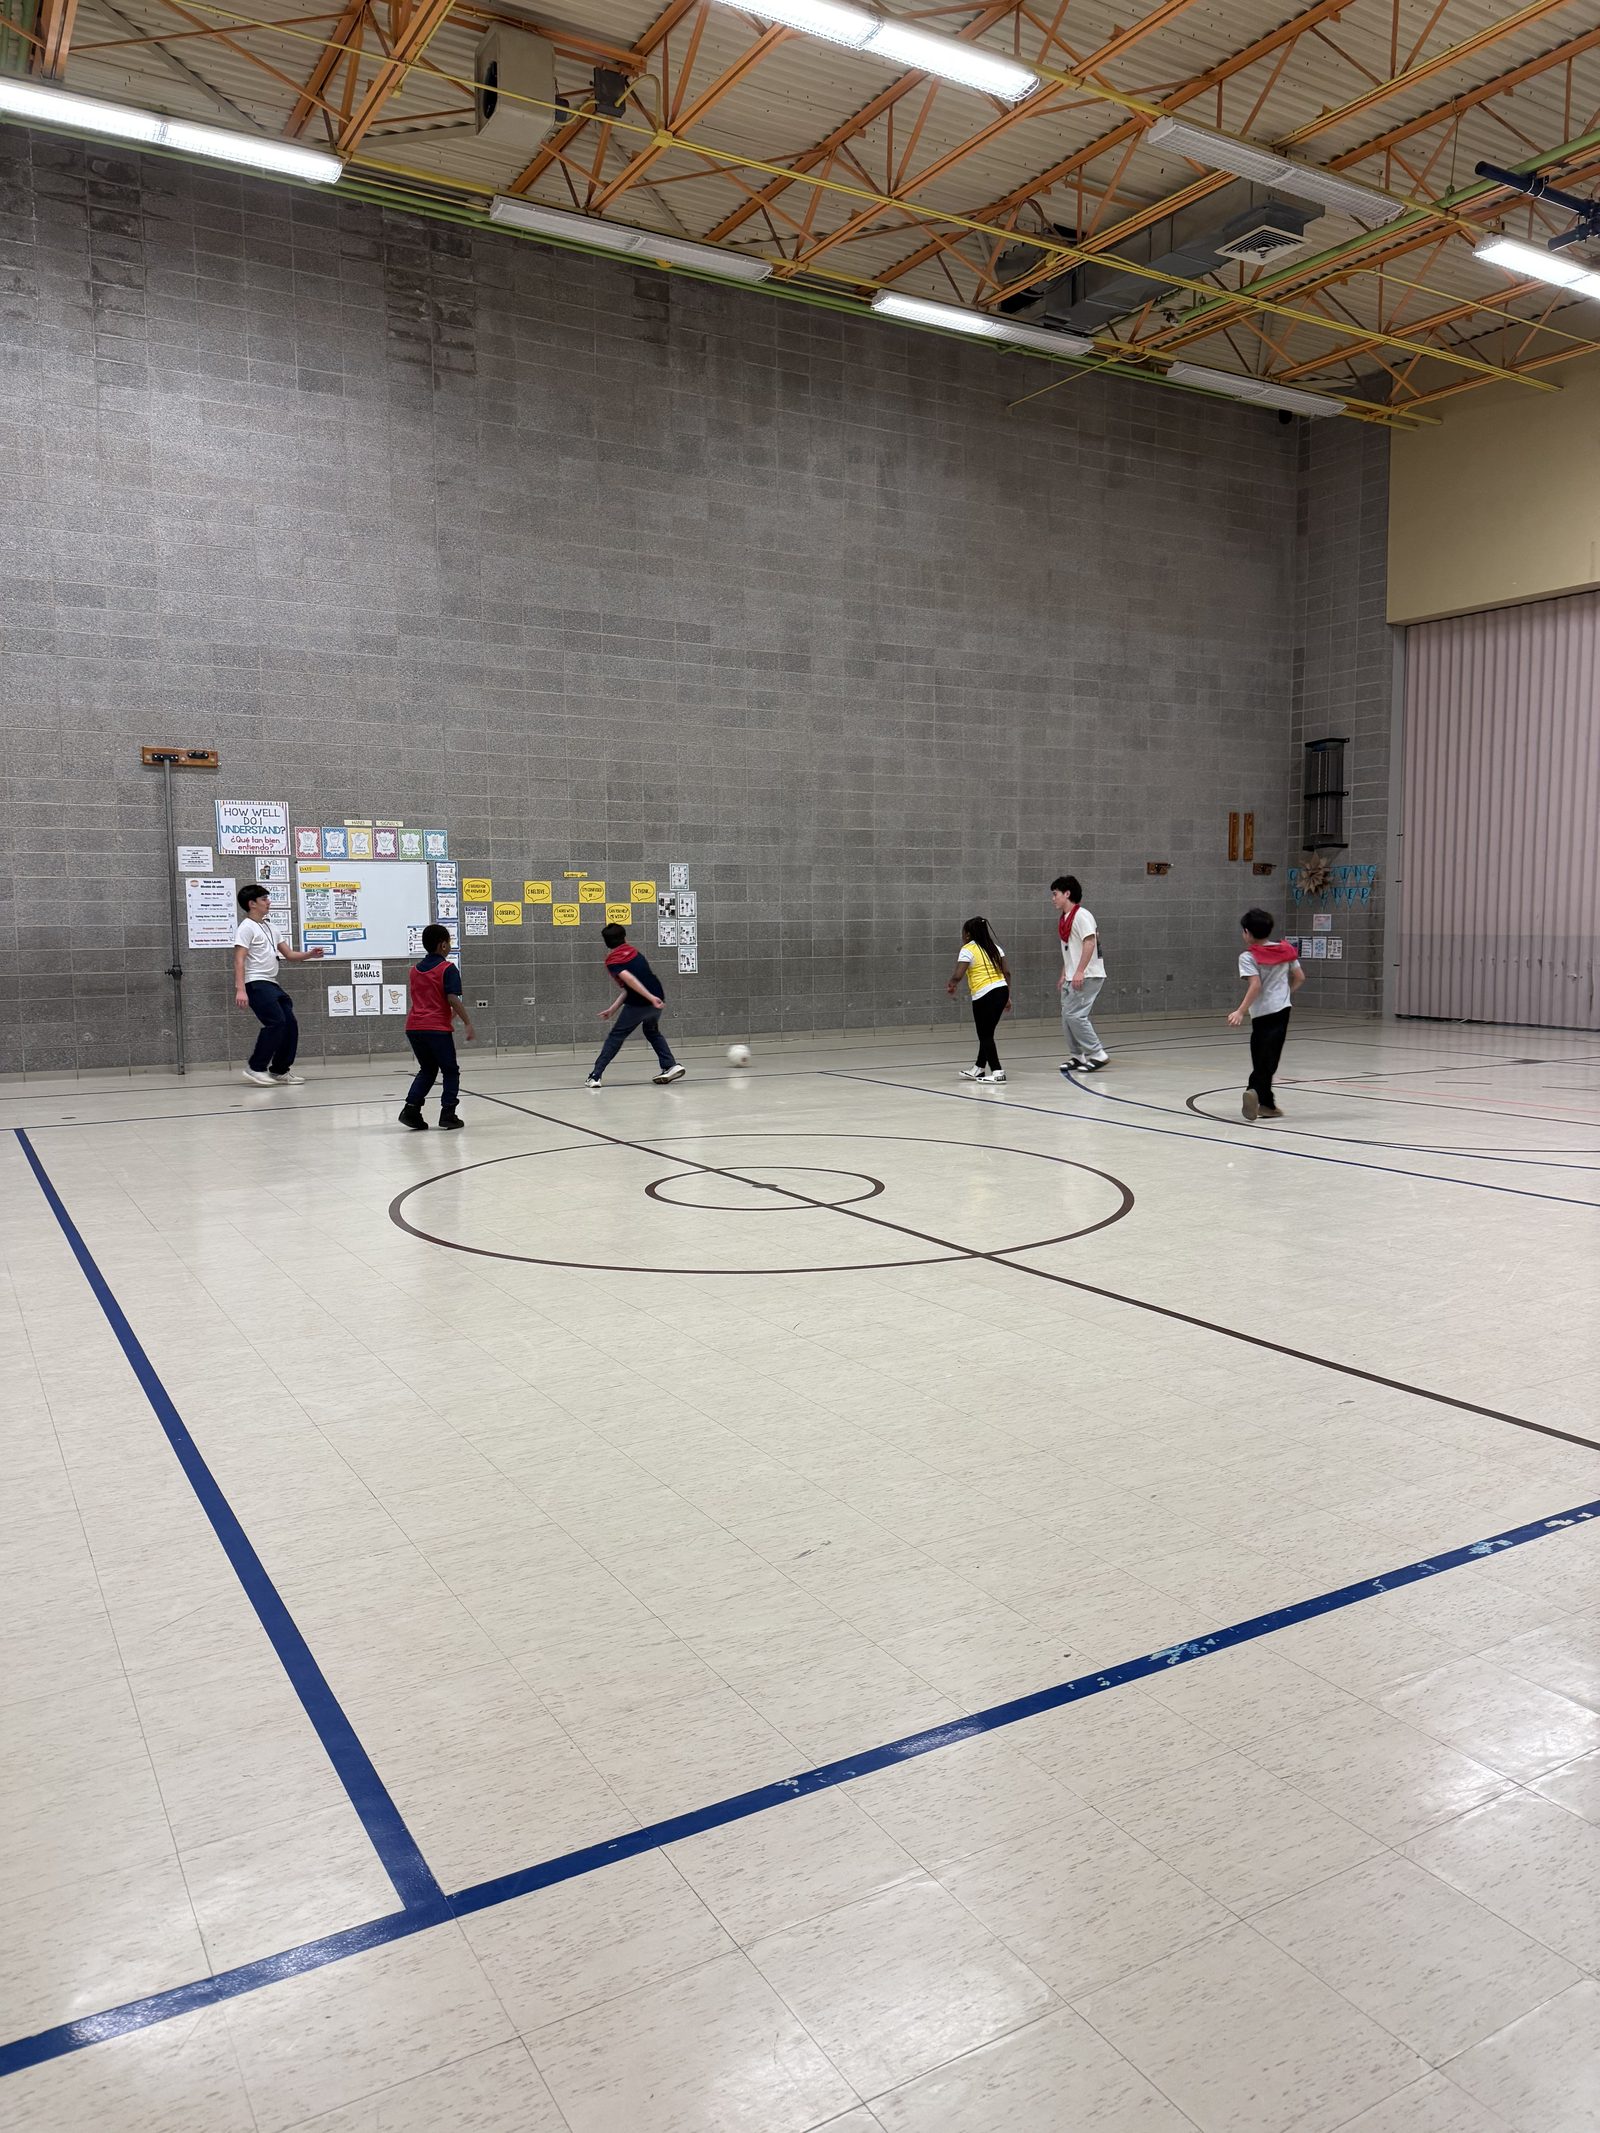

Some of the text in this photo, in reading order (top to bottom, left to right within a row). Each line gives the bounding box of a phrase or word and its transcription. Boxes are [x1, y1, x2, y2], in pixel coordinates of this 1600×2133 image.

[224, 808, 280, 817] HOW WELL
[244, 817, 257, 825] DO
[221, 825, 285, 834] UNDERSTAND?
